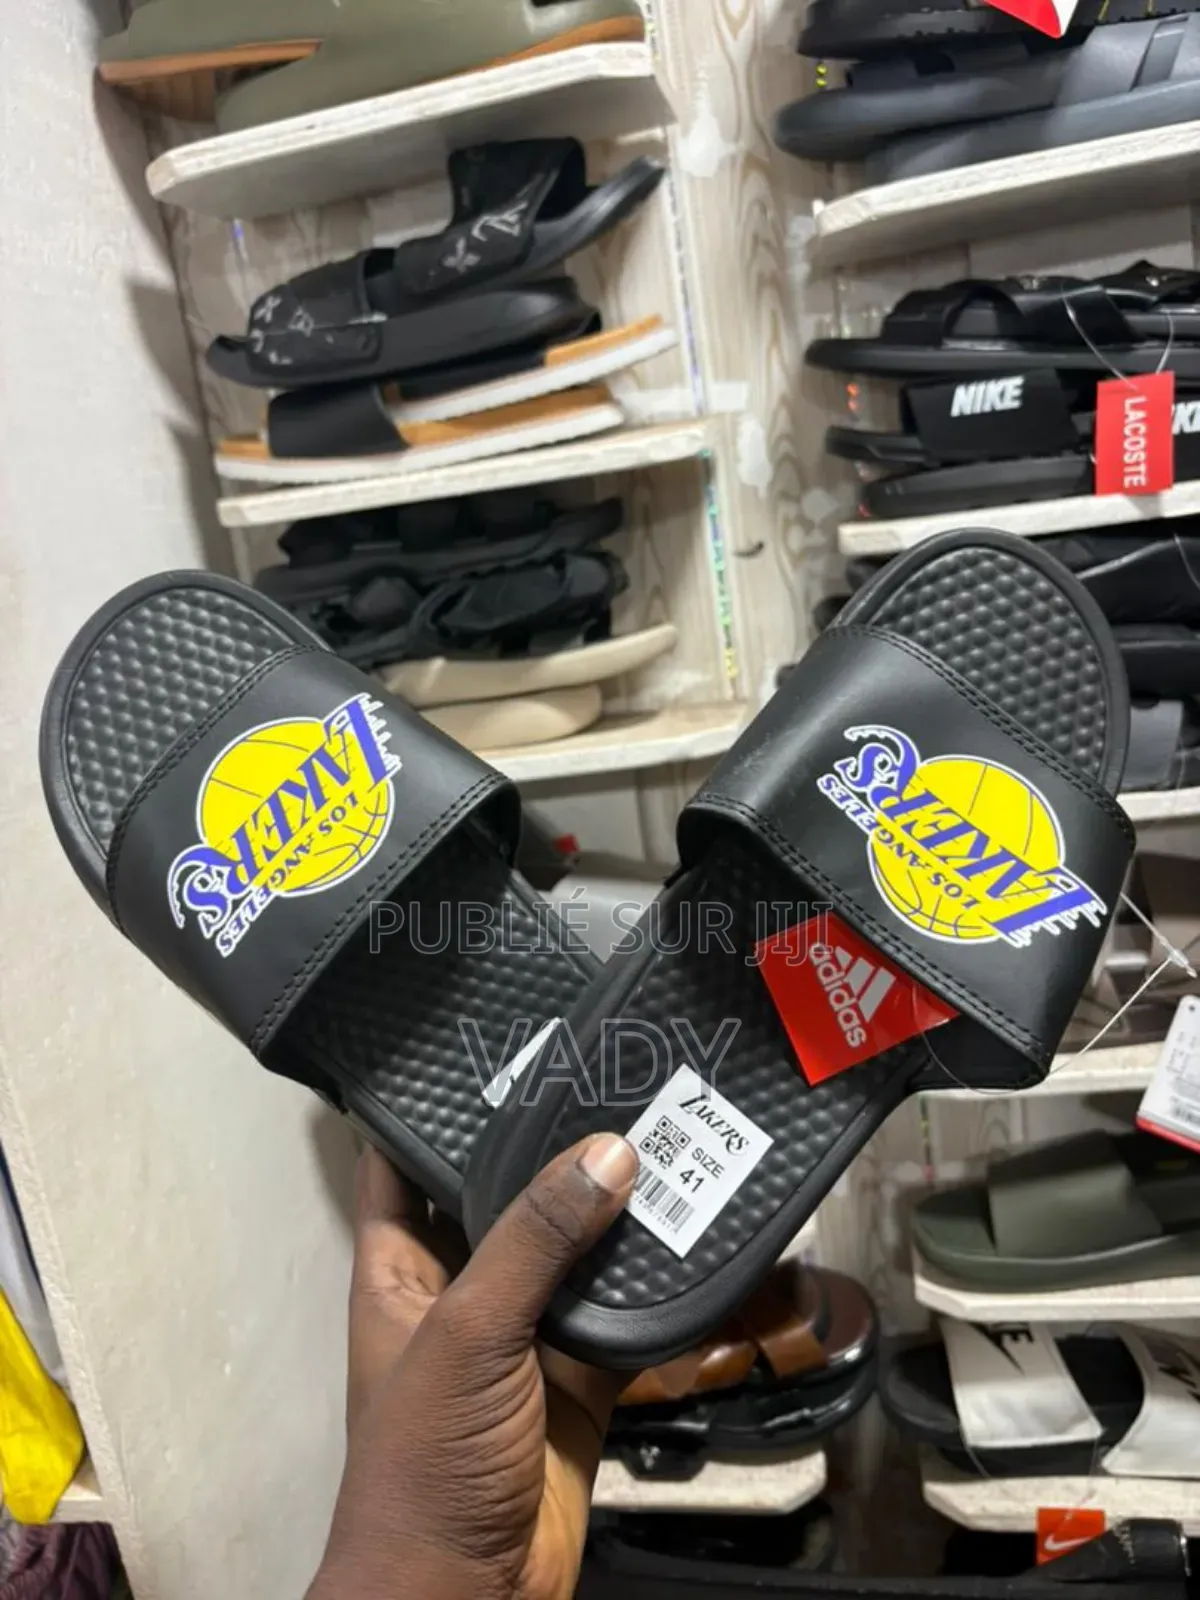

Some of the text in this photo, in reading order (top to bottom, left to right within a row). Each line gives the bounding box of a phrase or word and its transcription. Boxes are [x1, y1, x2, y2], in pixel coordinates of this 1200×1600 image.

[950, 375, 1025, 417] NIKE
[1122, 396, 1147, 489] LACOSTE
[167, 692, 402, 939] LAKERS
[817, 773, 981, 909] LOS ANGELES
[834, 725, 1107, 948] LAKERS
[215, 792, 359, 957] LOS ANGELES
[809, 942, 867, 1047] adidas
[678, 1093, 751, 1157] LAKERS
[690, 1146, 726, 1180] SIZE
[679, 1168, 706, 1194] 41
